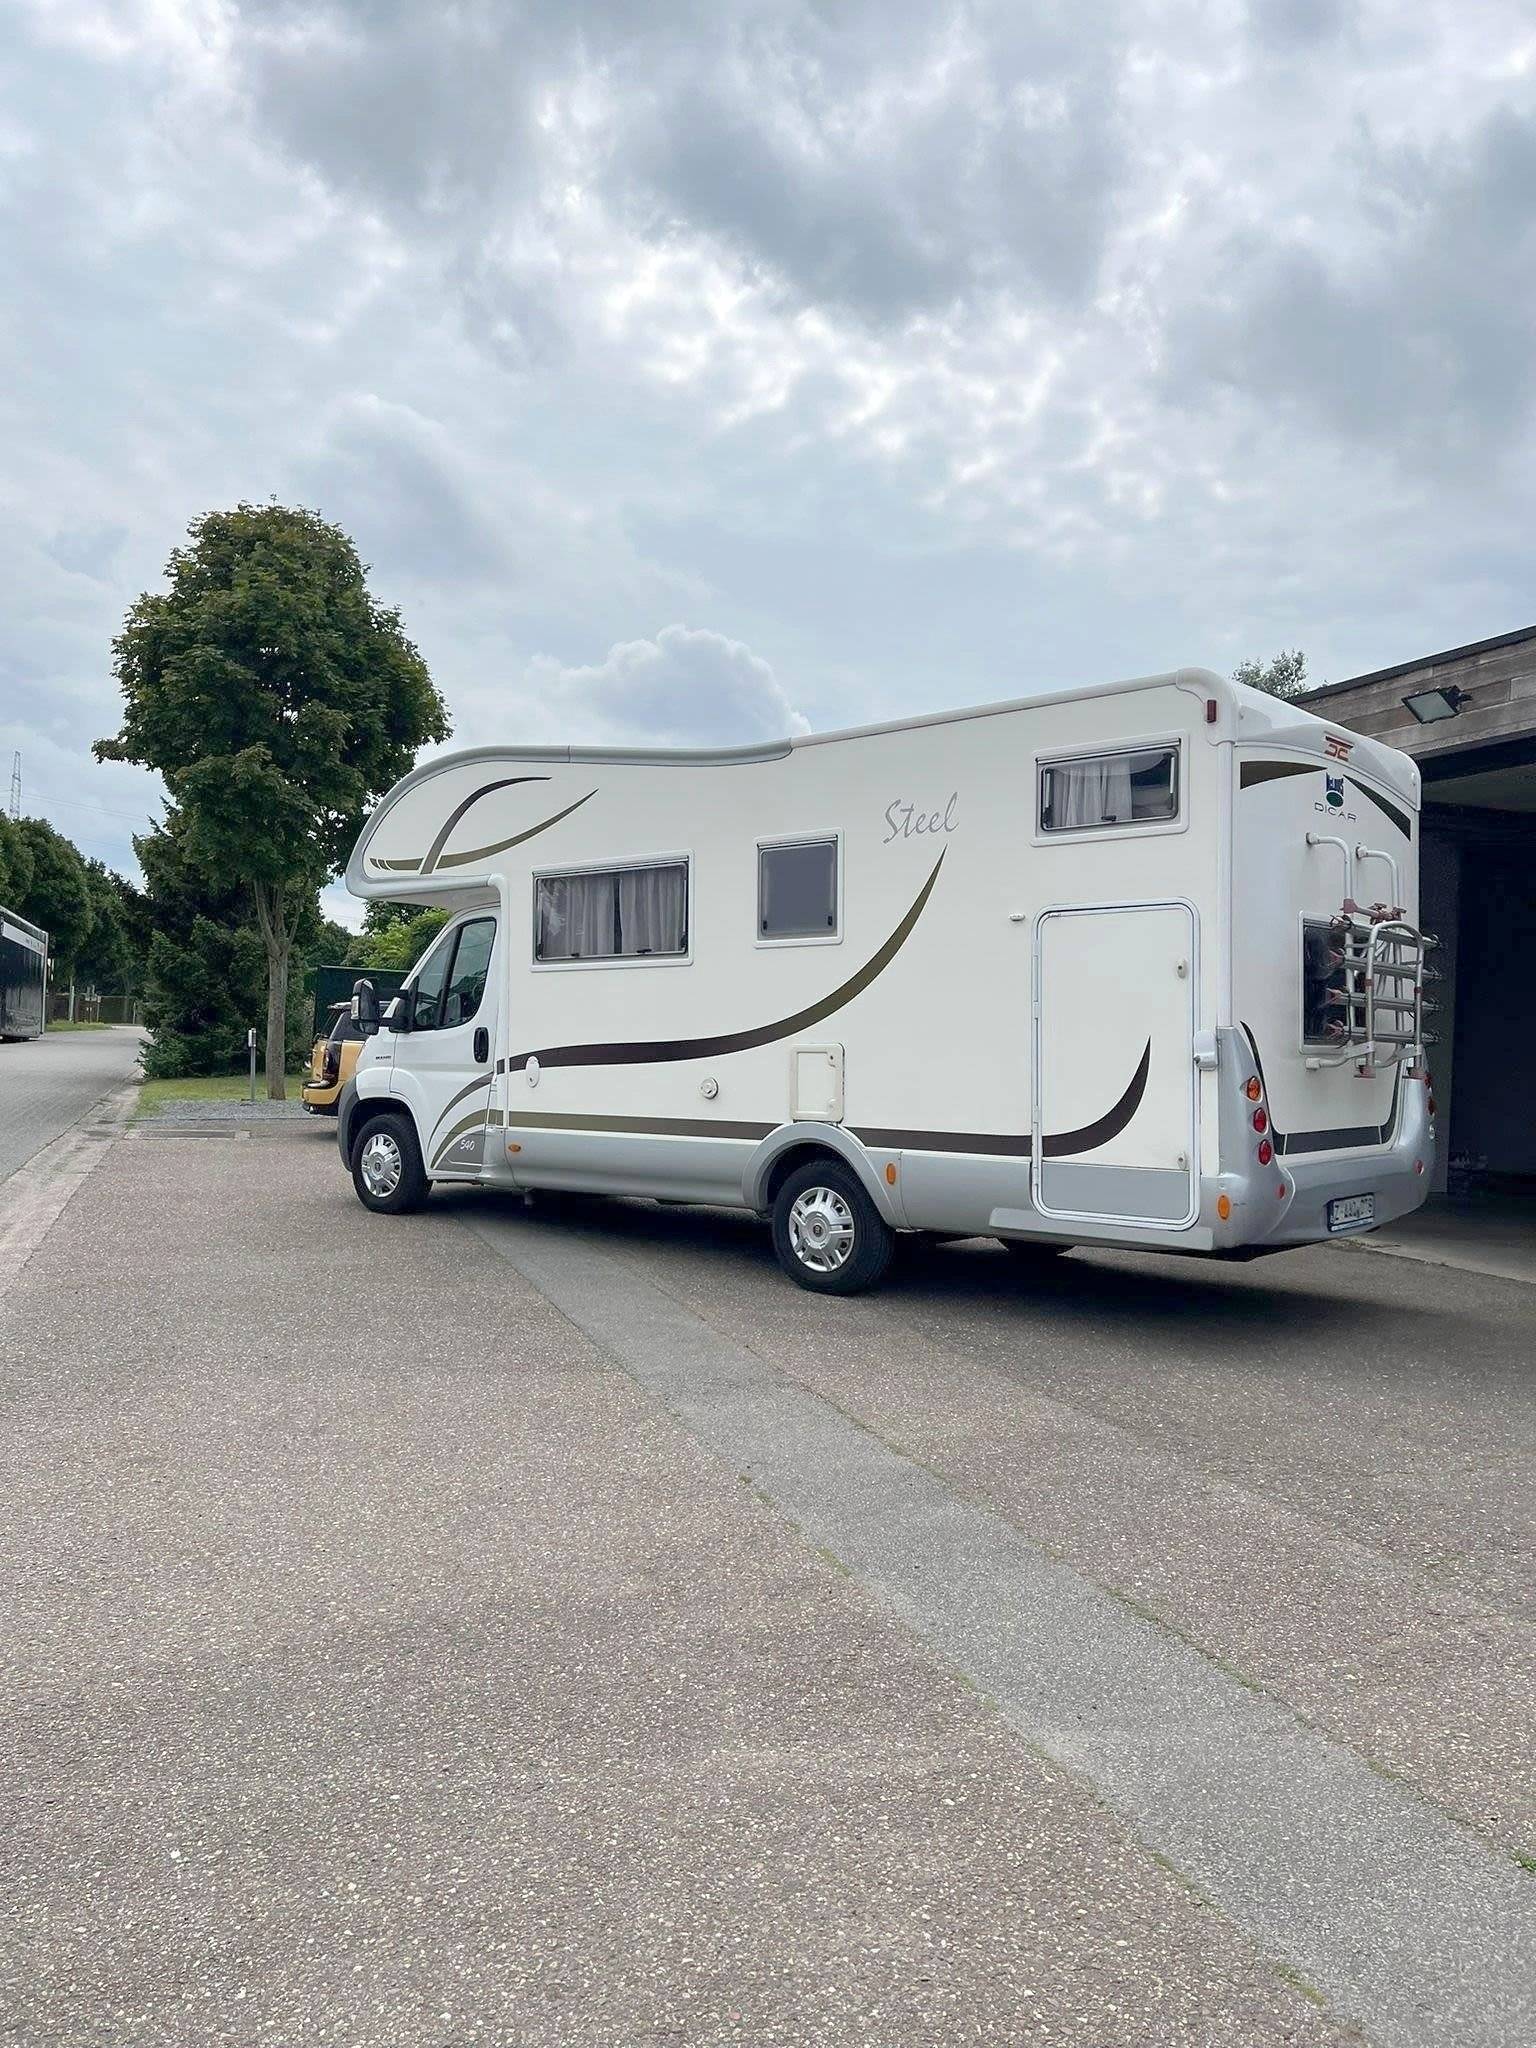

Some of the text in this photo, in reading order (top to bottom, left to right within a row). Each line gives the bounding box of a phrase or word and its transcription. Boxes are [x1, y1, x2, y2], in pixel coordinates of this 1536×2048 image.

[883, 792, 959, 844] Steel
[1314, 802, 1357, 821] DICAR
[460, 1139, 475, 1151] 540
